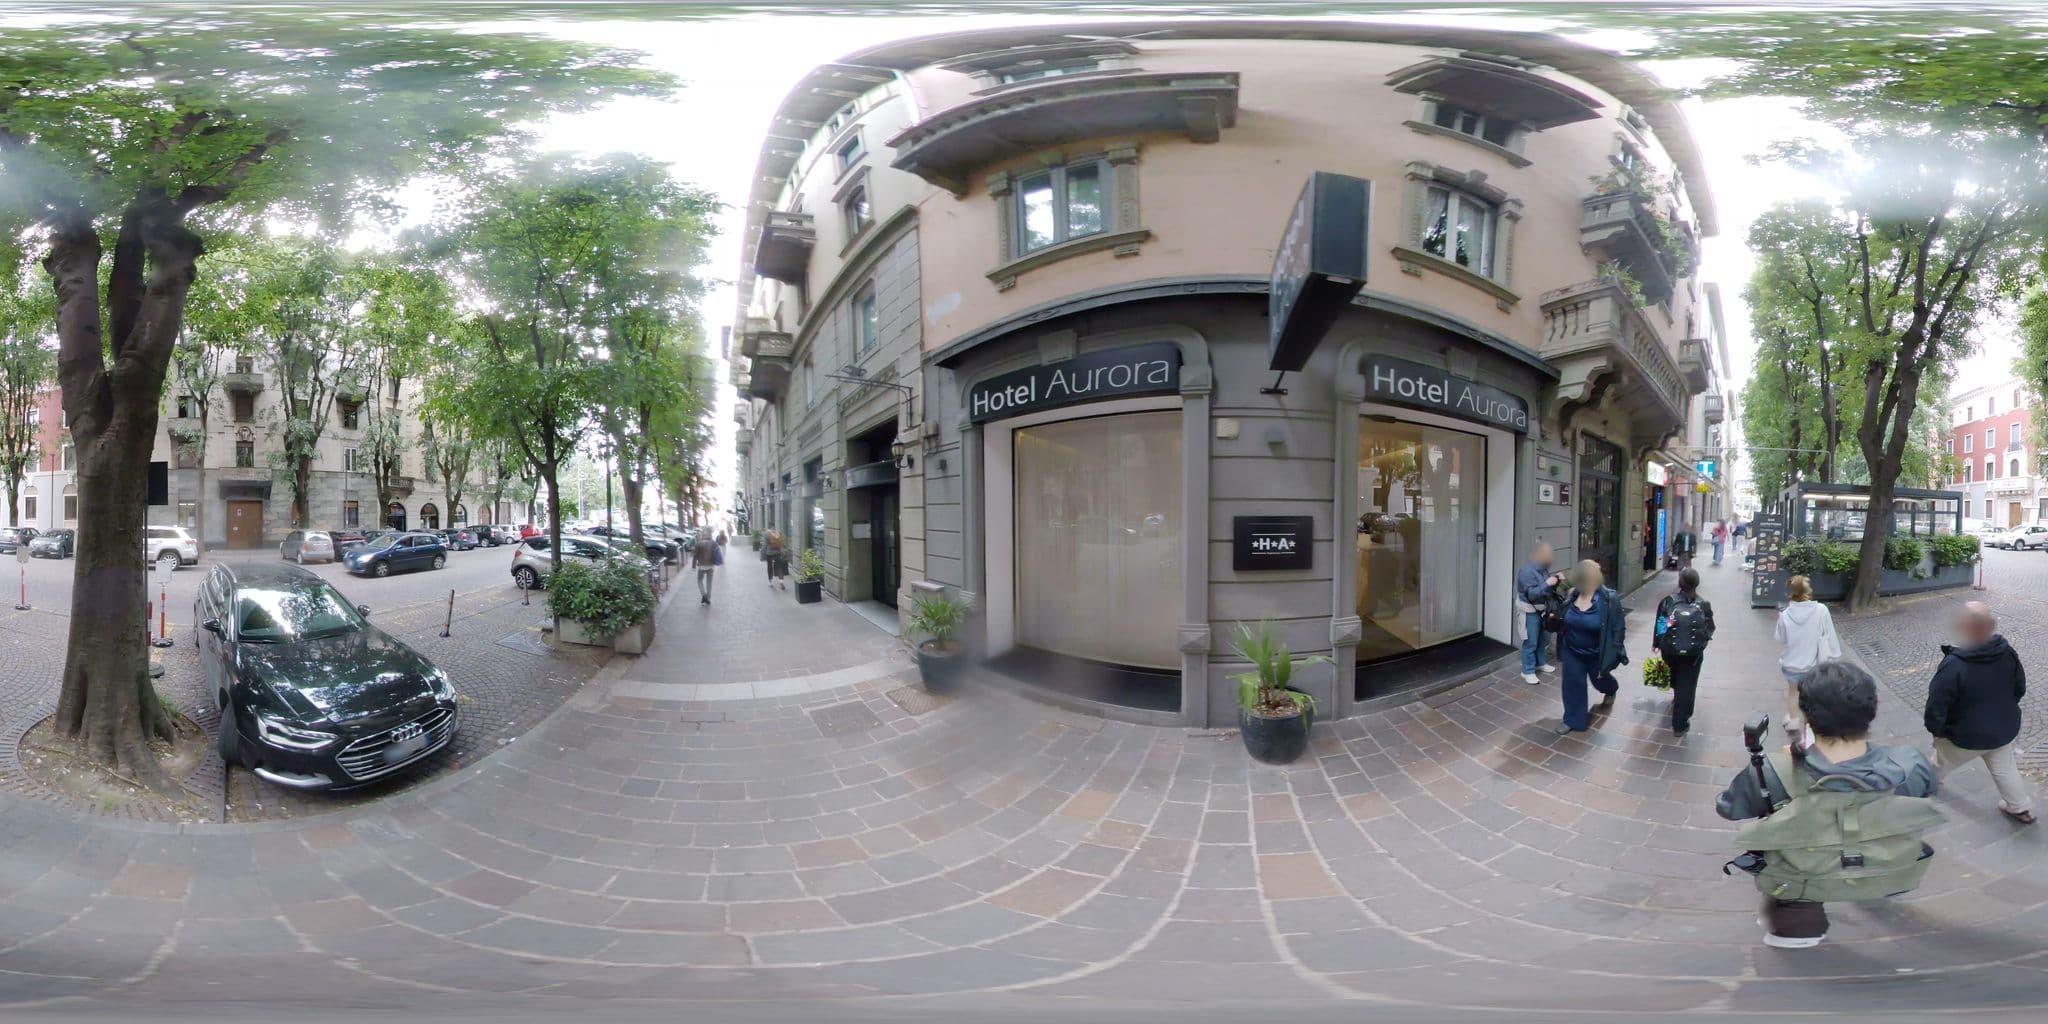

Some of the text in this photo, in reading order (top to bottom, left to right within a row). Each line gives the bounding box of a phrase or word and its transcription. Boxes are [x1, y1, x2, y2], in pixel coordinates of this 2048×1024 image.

[974, 360, 1169, 416] Hotel Aurora
[1373, 365, 1526, 428] Hotel Aurora
